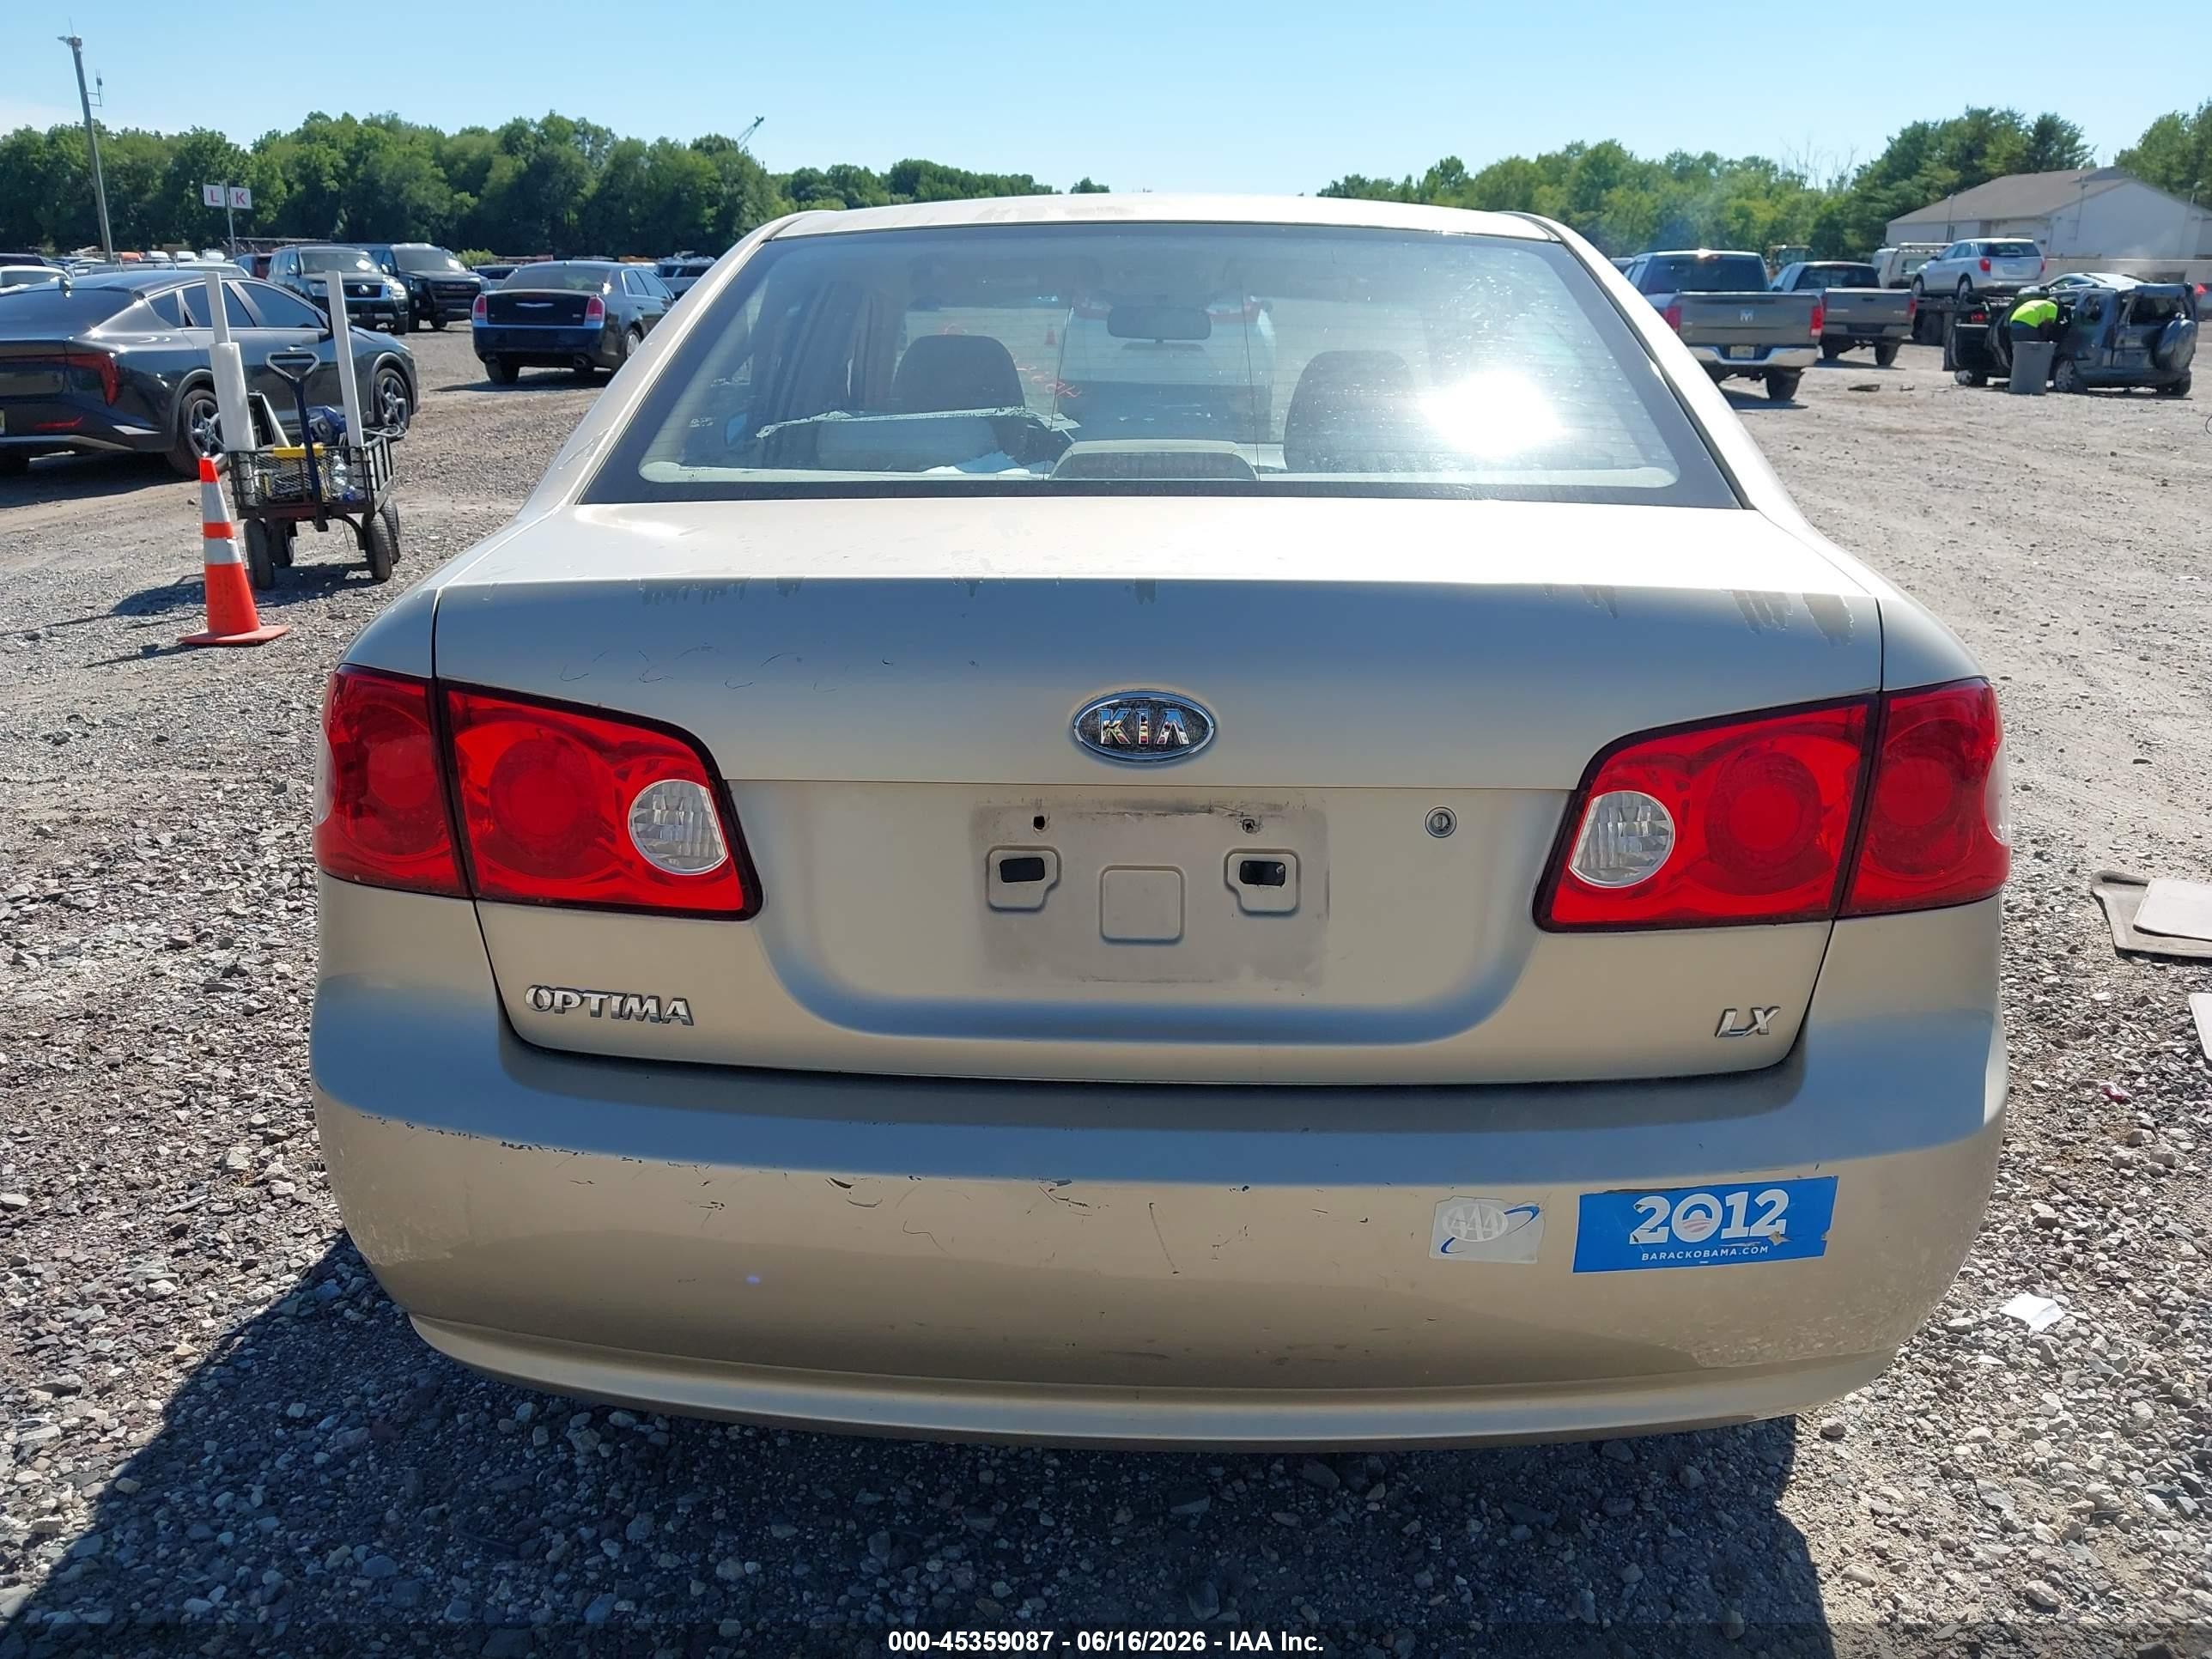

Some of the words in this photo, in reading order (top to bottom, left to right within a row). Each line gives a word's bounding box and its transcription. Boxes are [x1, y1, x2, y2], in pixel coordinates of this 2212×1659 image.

[210, 189, 220, 203] L
[235, 191, 246, 205] K
[1098, 708, 1190, 745] KIA
[525, 984, 694, 1026] OPTIMA
[1714, 1006, 1781, 1037] LX
[1449, 1203, 1500, 1241] AAA
[1629, 1188, 1790, 1244] 2012
[1641, 1245, 1769, 1261] BARACKOBAMA.COM
